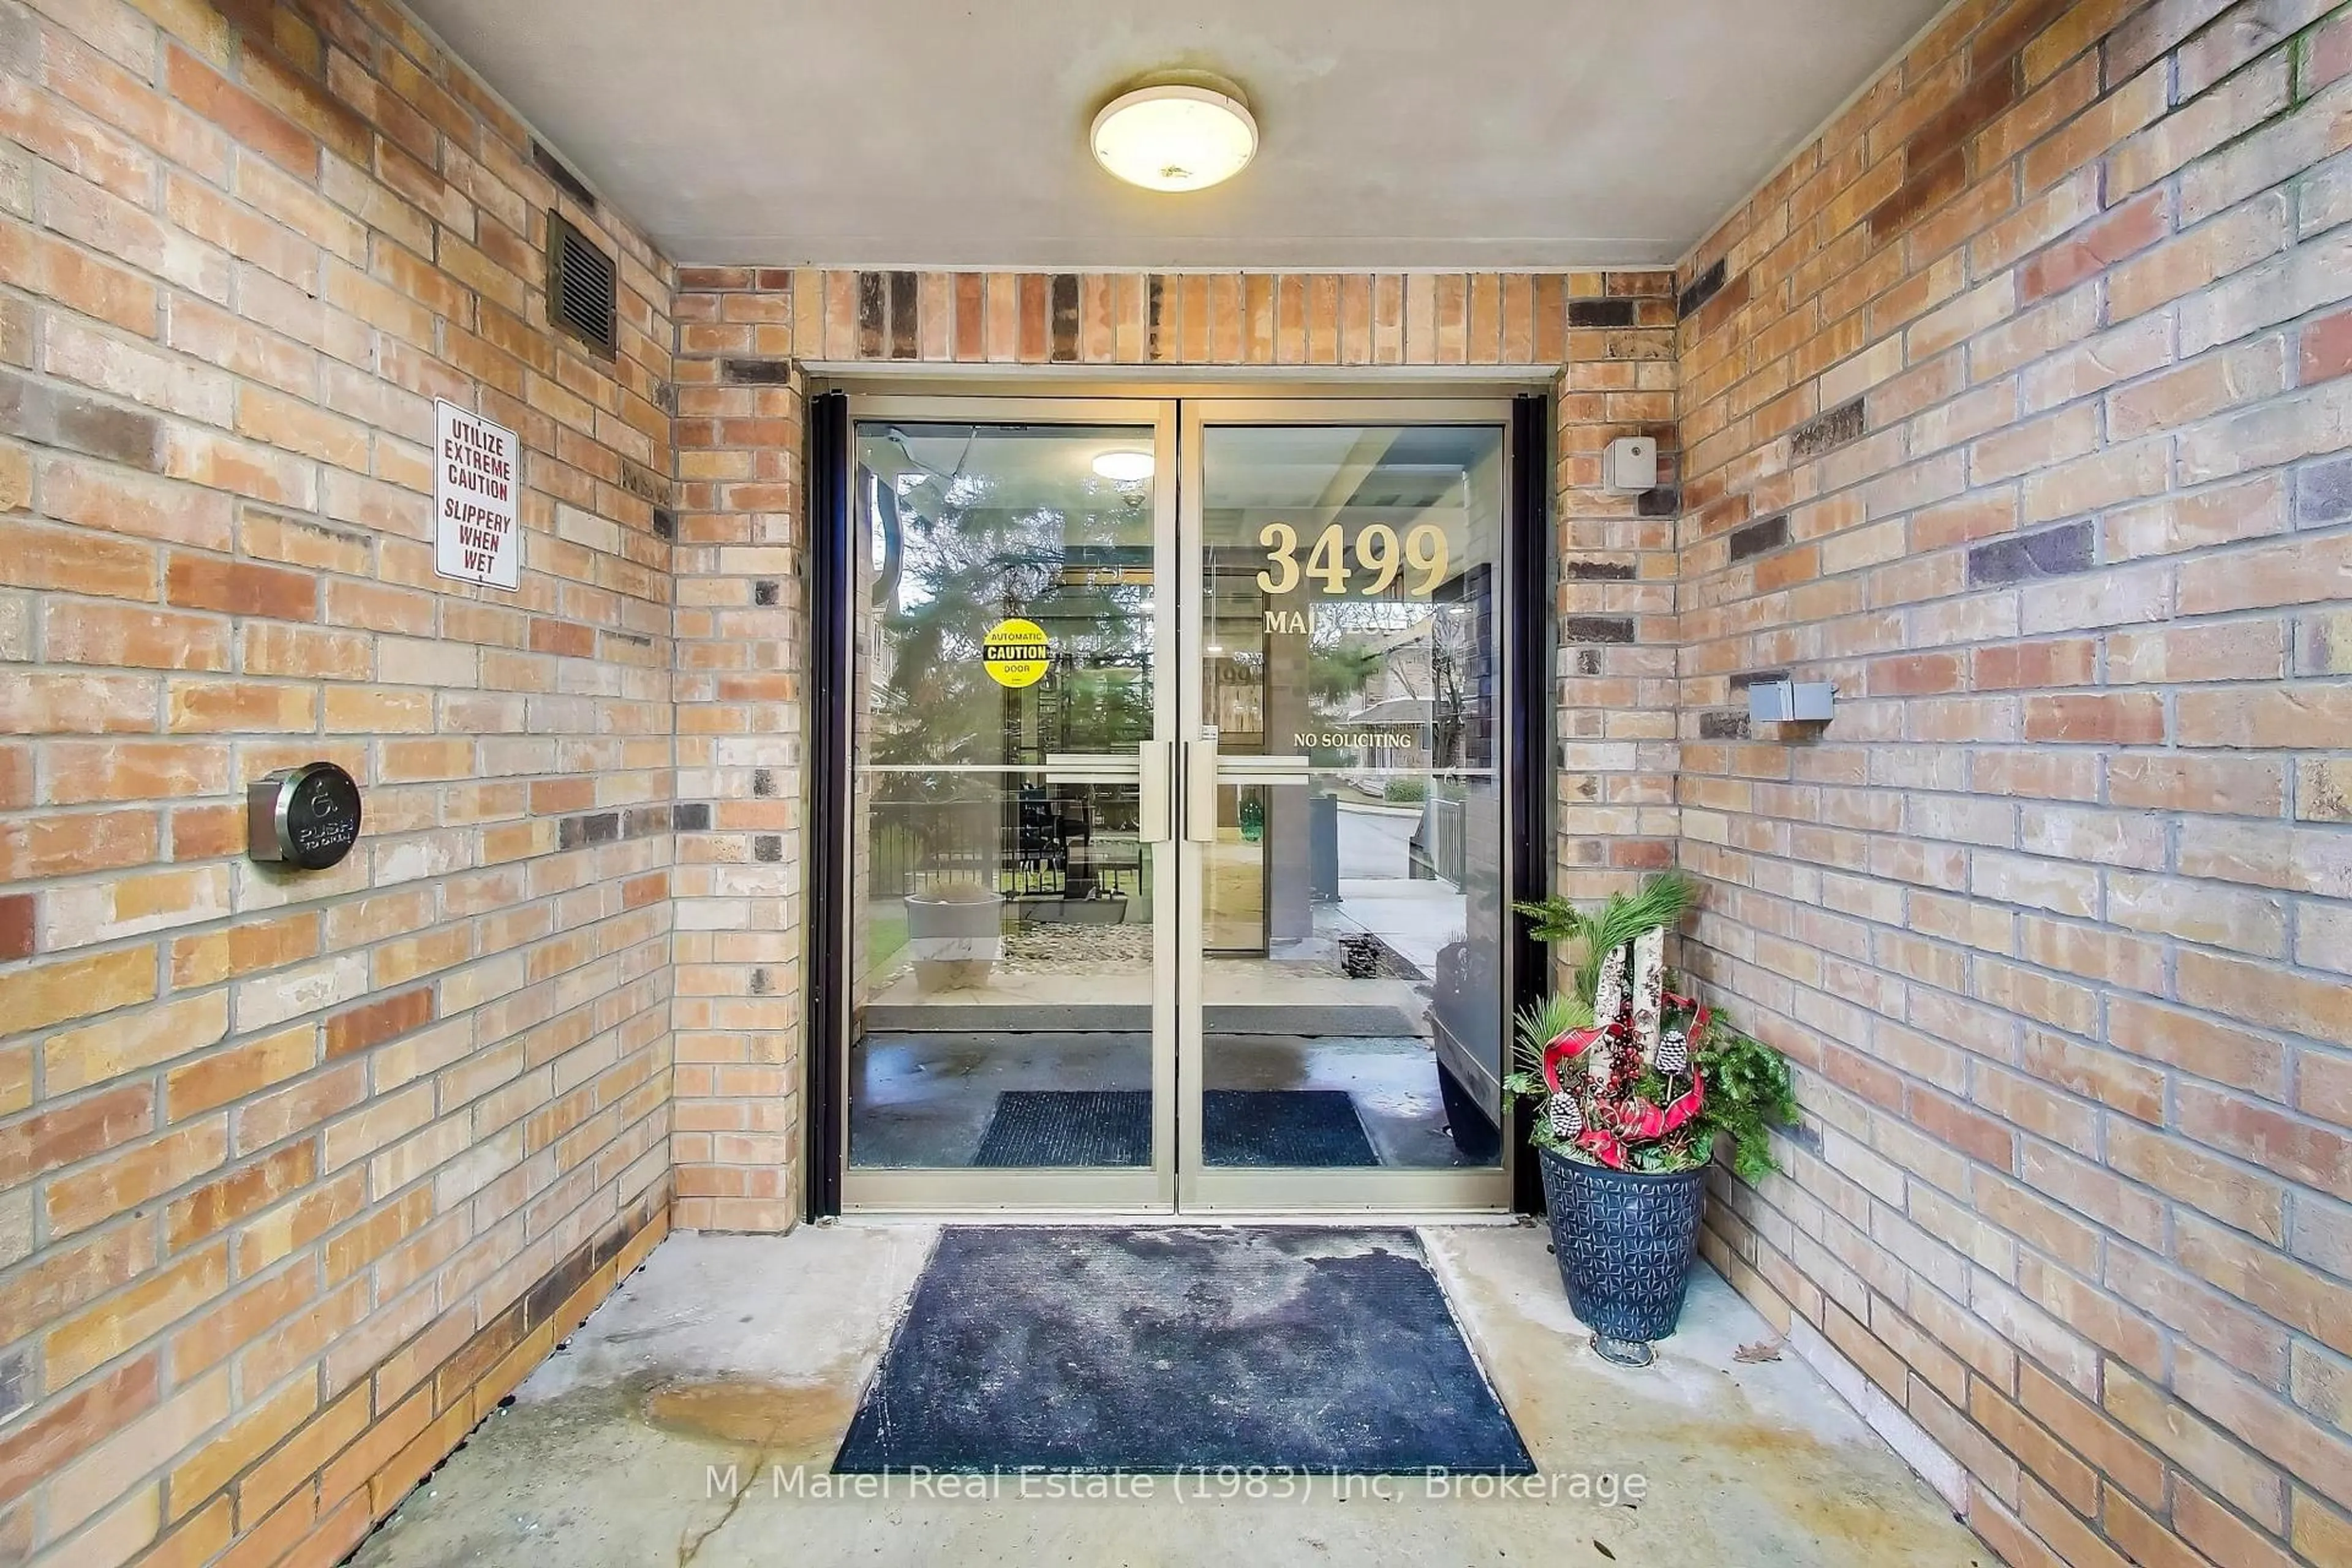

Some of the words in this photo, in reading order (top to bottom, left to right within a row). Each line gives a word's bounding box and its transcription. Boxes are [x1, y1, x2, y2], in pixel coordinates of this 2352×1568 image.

[452, 418, 503, 456] UTILIZE
[444, 439, 510, 481] EXTREME
[448, 464, 507, 502] CAUTION
[444, 498, 511, 534] SLIPPERY
[459, 525, 499, 552] WHEN
[464, 549, 495, 575] WET
[1256, 523, 1449, 595] 3499
[991, 632, 1042, 641] AUTOMATIC
[987, 646, 1046, 660] CAUTION
[1294, 733, 1317, 747] NO
[1321, 733, 1411, 748] SOLICITING
